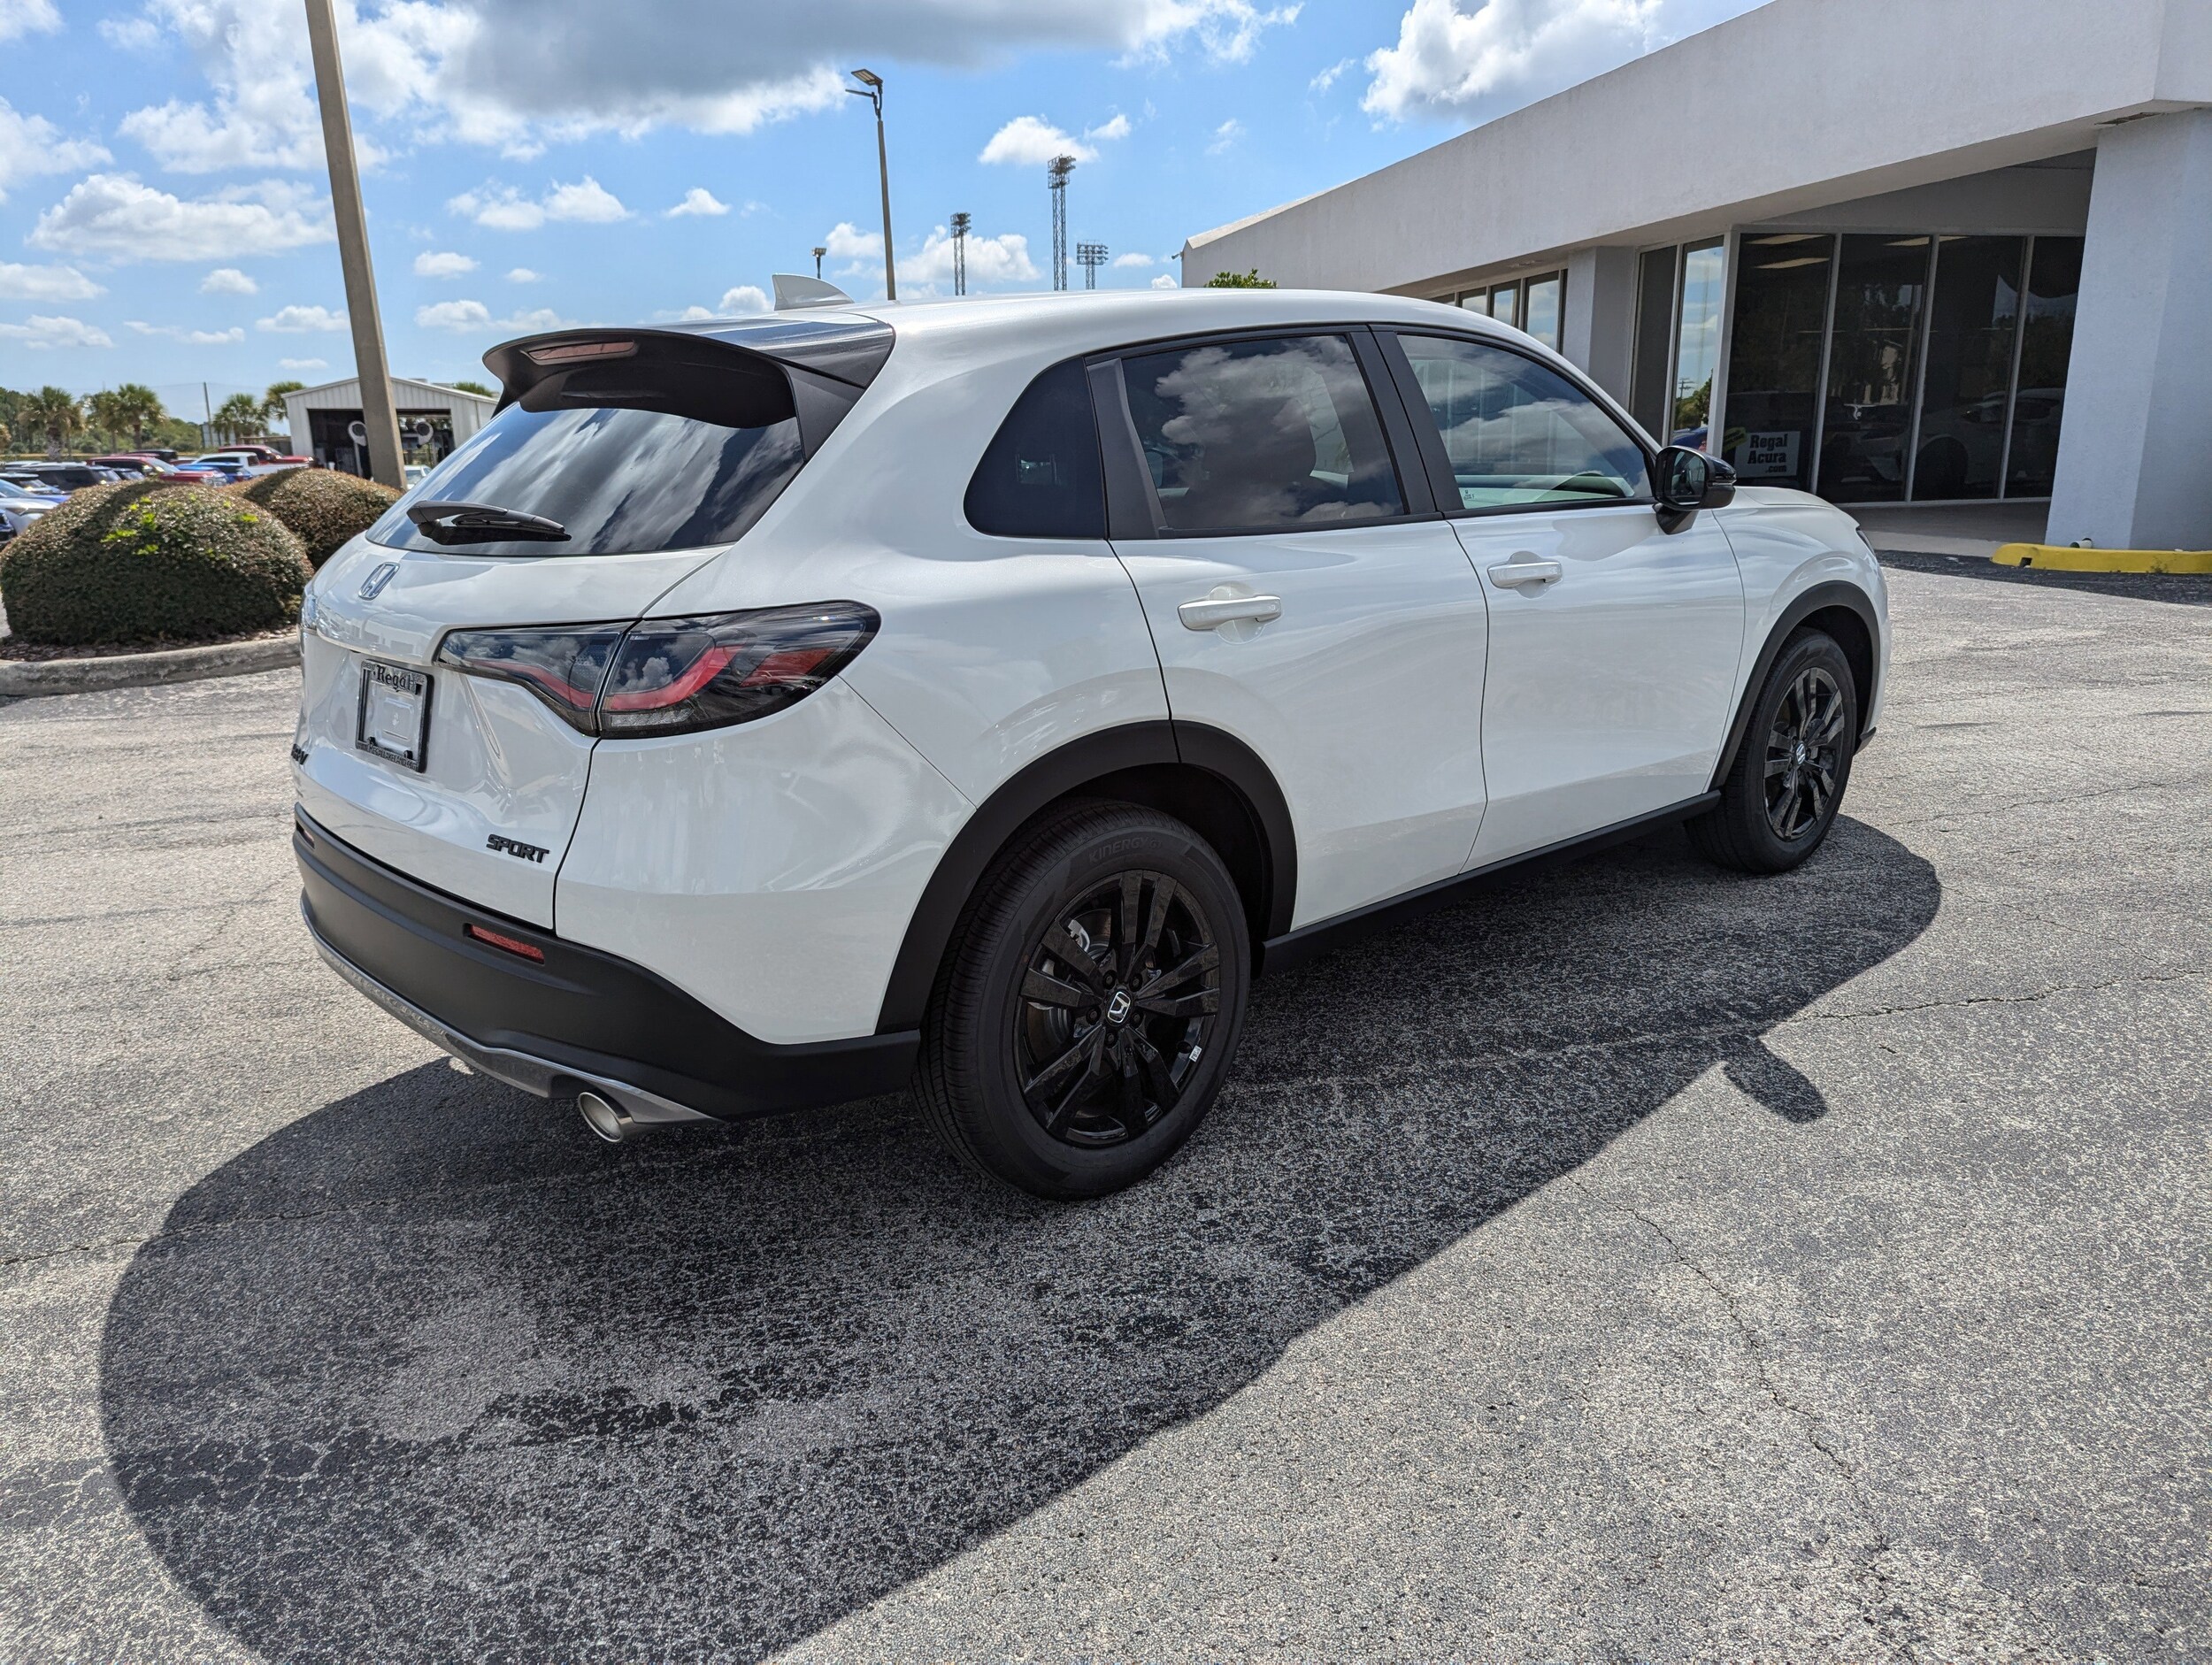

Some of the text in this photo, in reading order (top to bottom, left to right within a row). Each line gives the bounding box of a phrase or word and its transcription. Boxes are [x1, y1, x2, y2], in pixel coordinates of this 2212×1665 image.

[1749, 434, 1787, 451] Regal
[1747, 450, 1786, 464] Acura
[376, 664, 411, 692] Regal
[486, 833, 549, 863] SPORT
